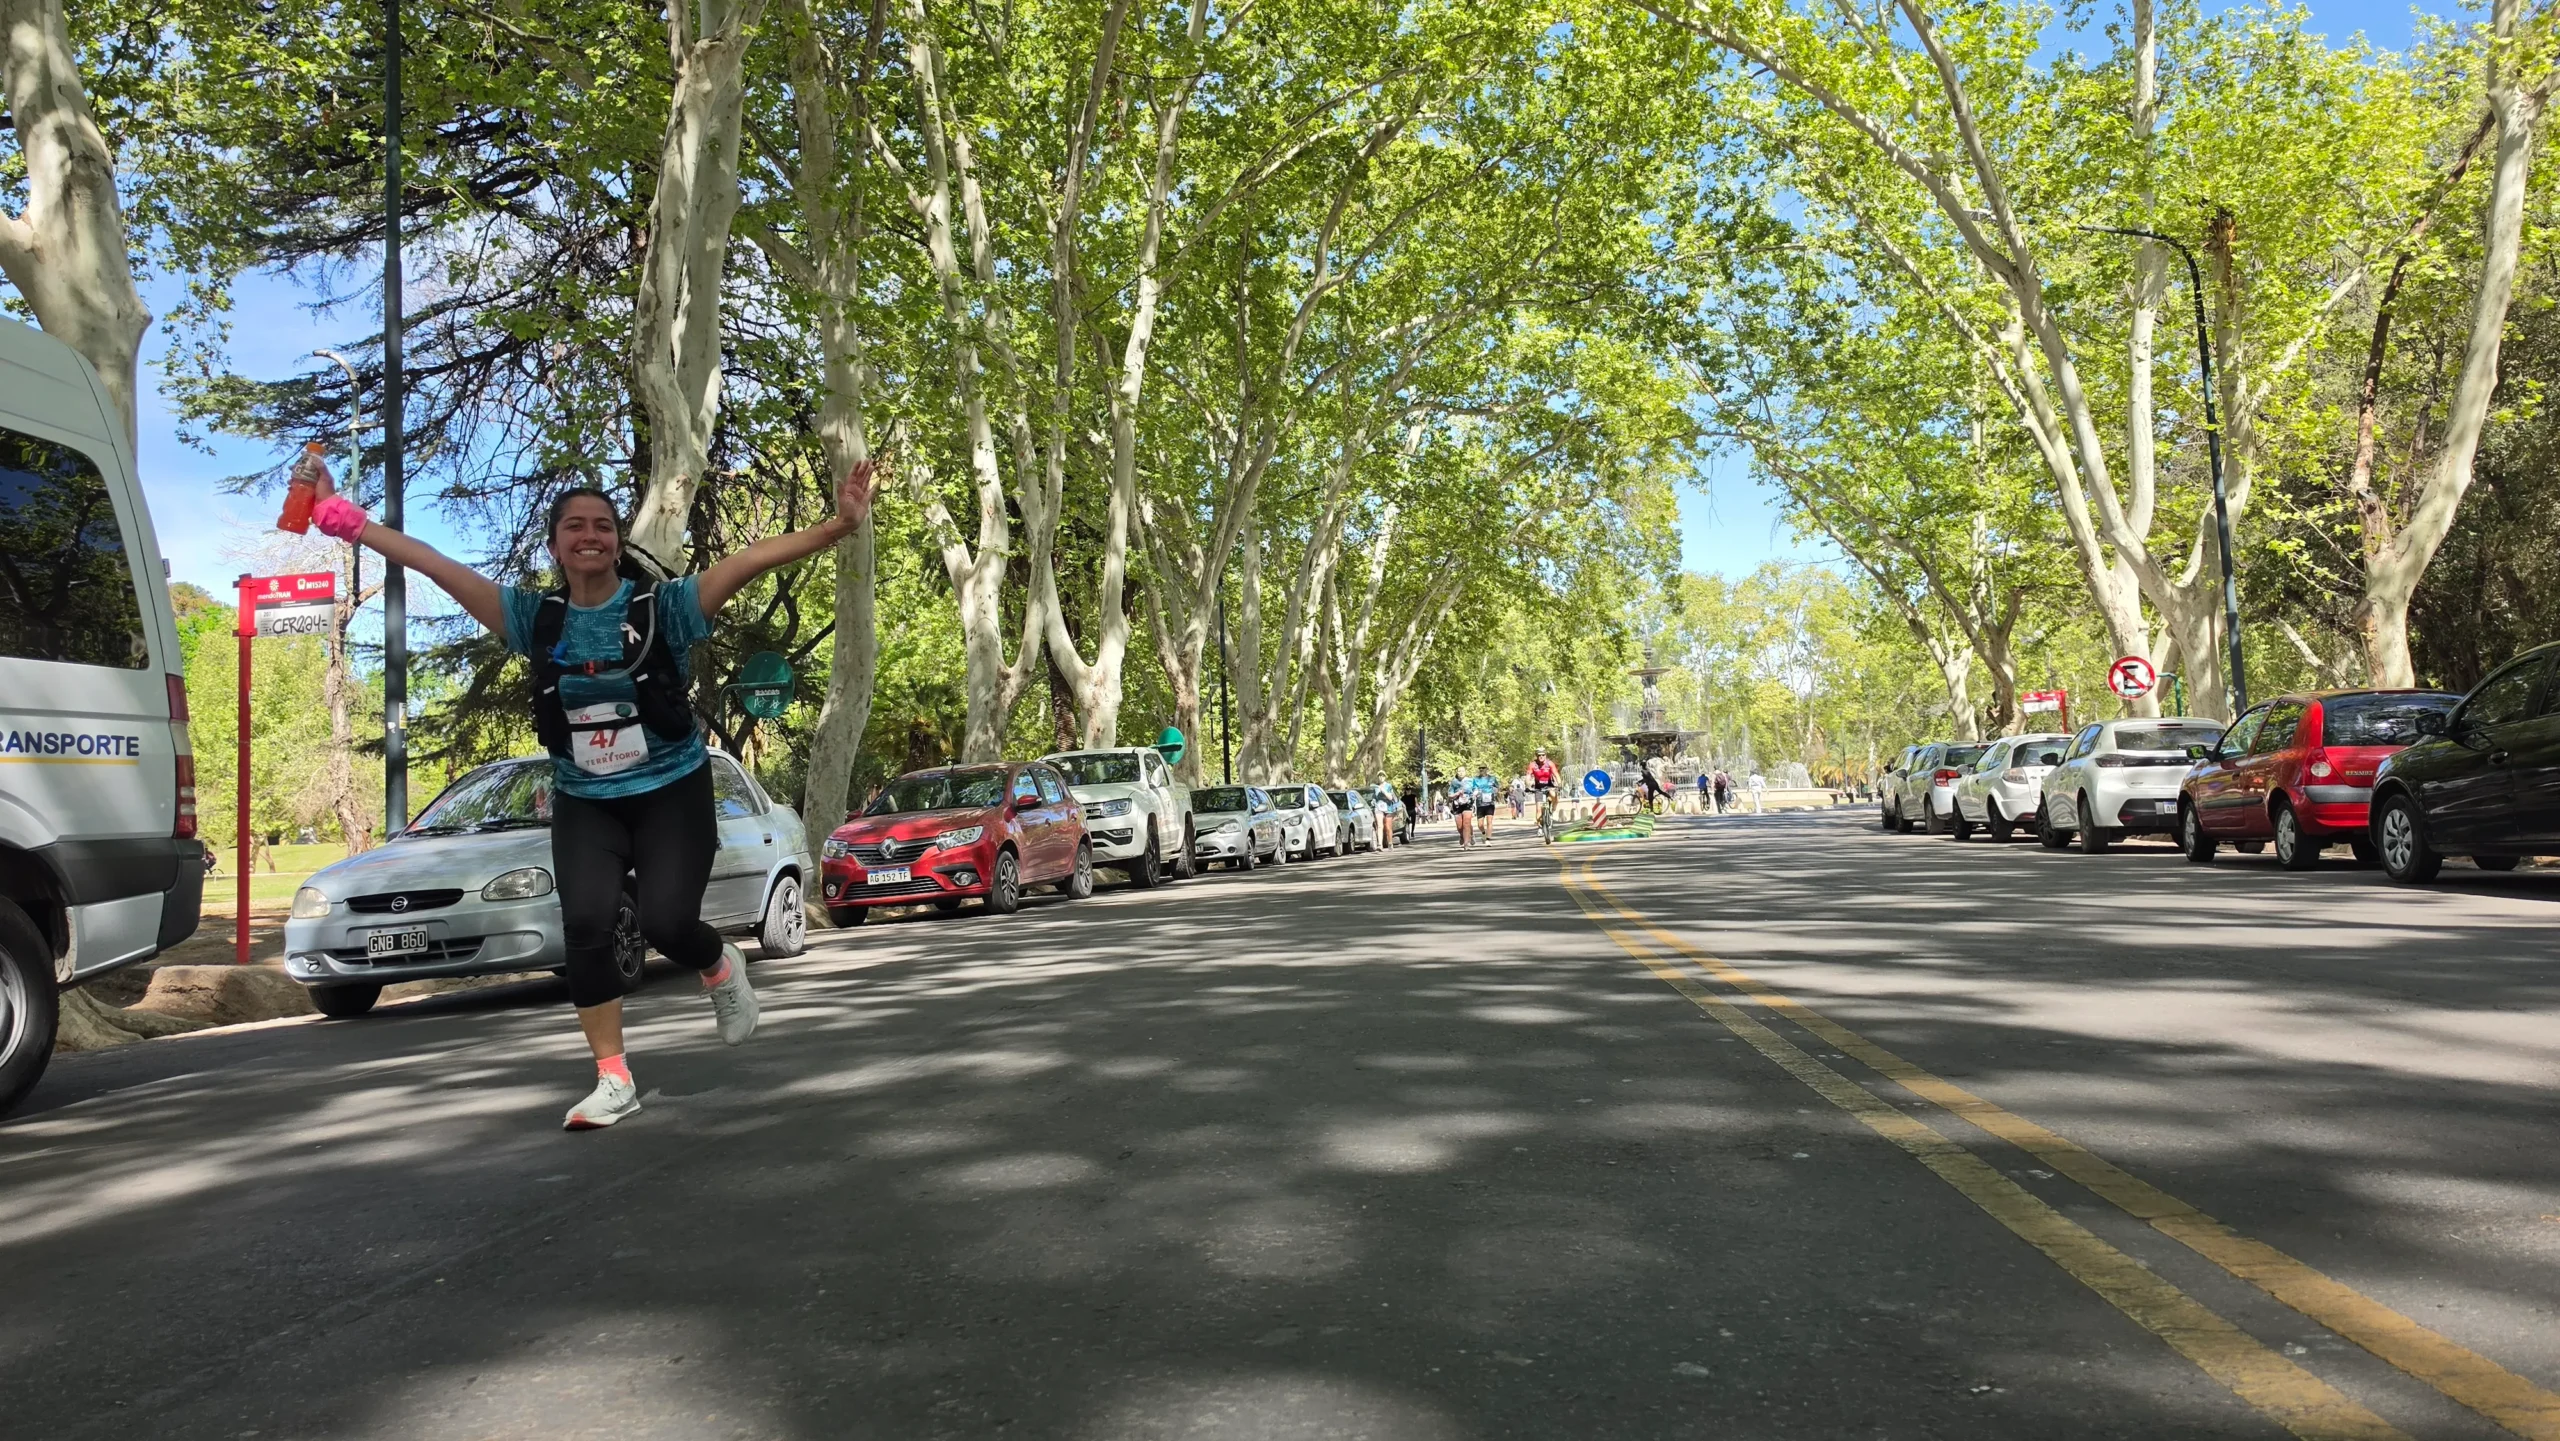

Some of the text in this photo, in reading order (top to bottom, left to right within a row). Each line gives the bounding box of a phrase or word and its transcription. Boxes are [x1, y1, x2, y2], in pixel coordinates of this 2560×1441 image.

[306, 581, 329, 589] M15240
[0, 731, 140, 756] ANSPORTE
[589, 729, 619, 749] 47
[585, 749, 640, 767] TERRITORIO
[2166, 805, 2177, 813] AH
[870, 872, 908, 883] AG 152 TF
[370, 932, 424, 952] GNB 860
